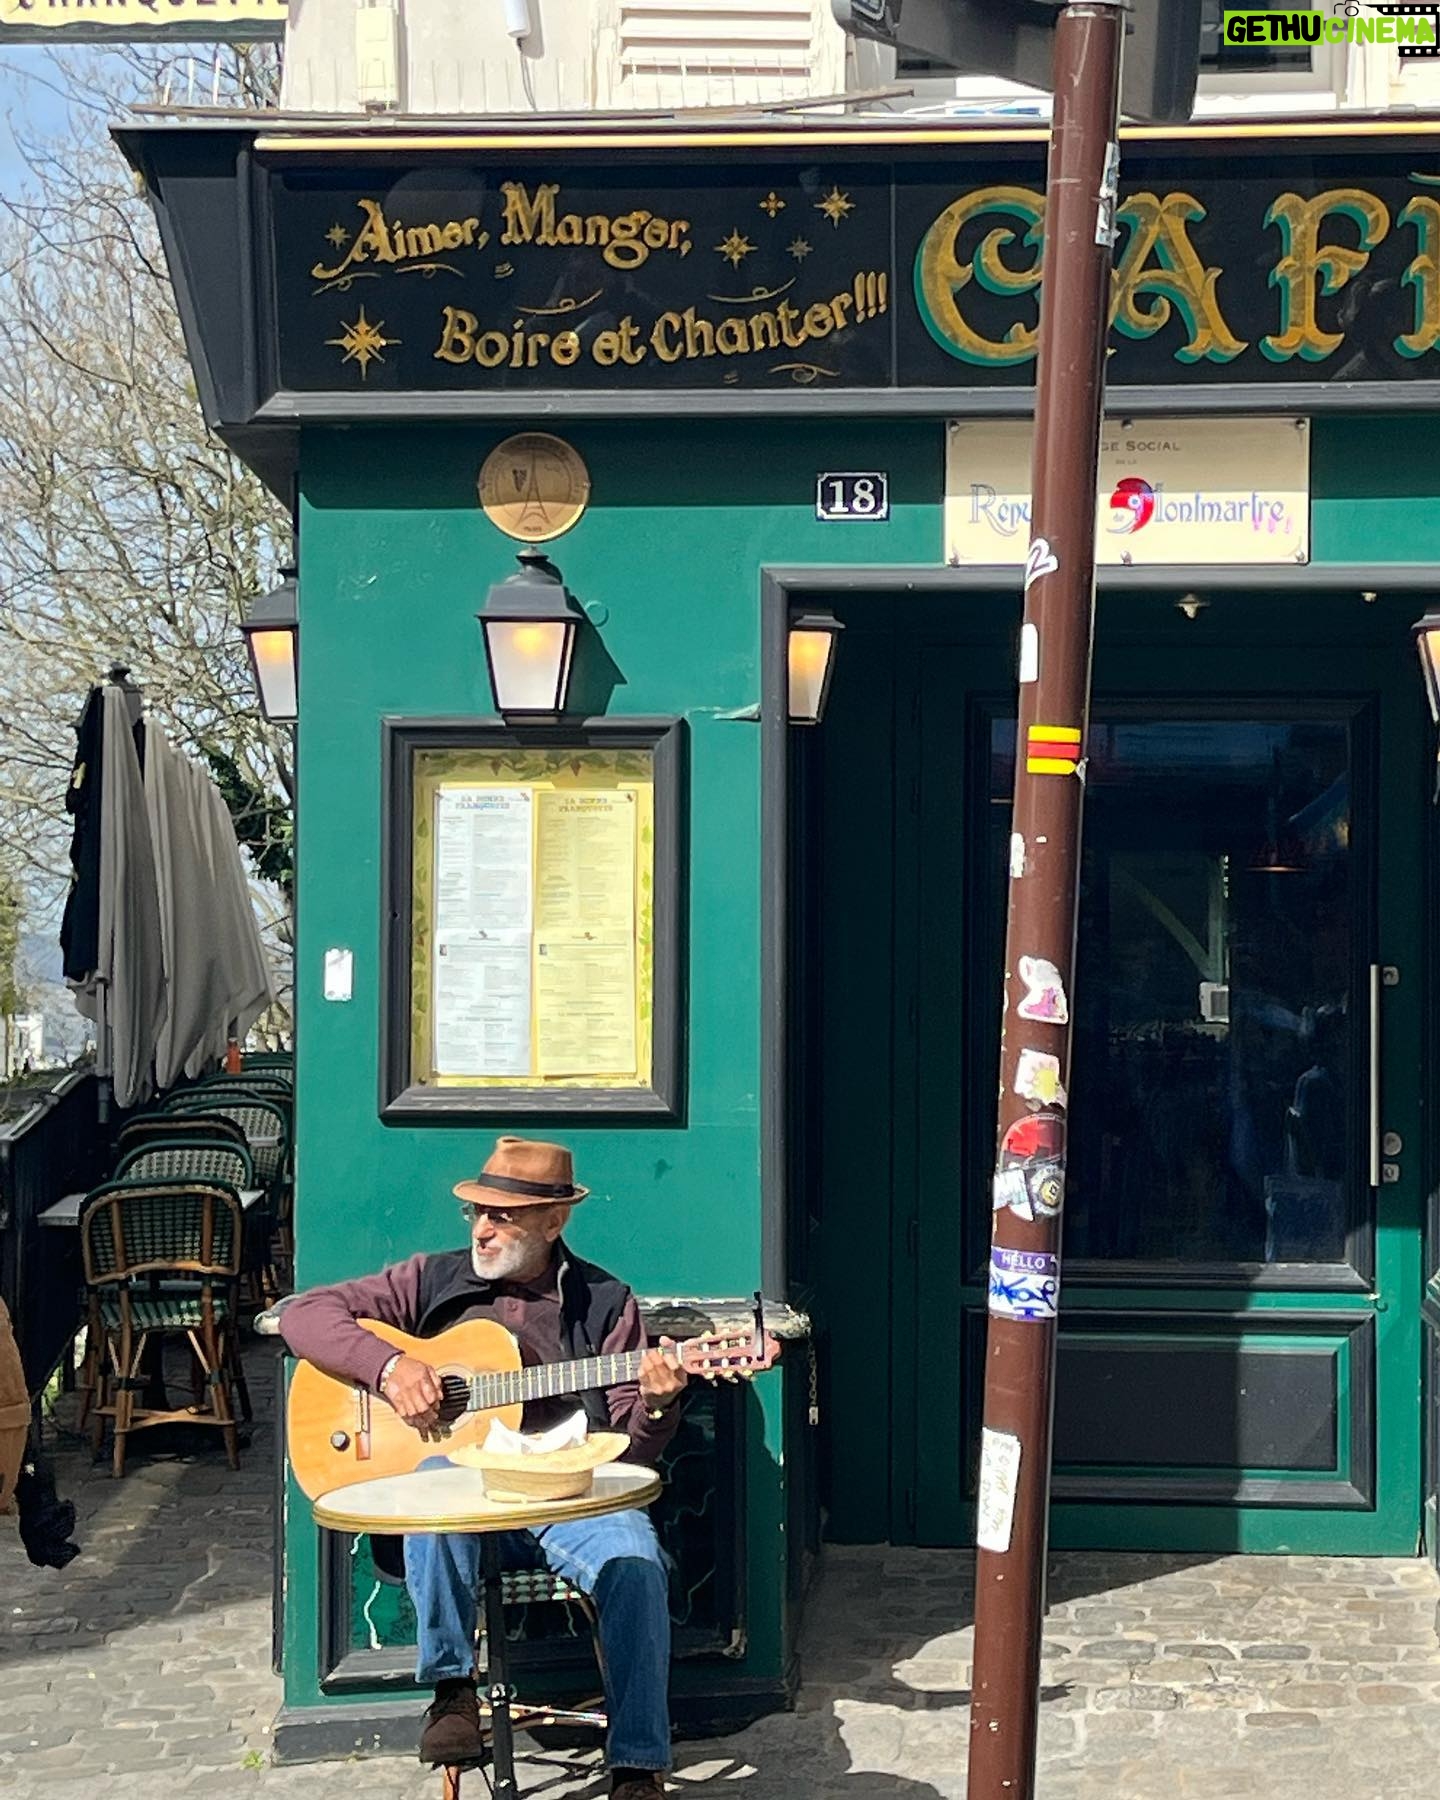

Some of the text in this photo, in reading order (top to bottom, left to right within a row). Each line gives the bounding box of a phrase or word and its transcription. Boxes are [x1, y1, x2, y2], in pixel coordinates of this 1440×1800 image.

[311, 181, 692, 278] Aimer, Manger,
[434, 271, 887, 368] Boire et Chanter!!!
[829, 479, 876, 513] 18
[1002, 1252, 1046, 1270] HELLO
